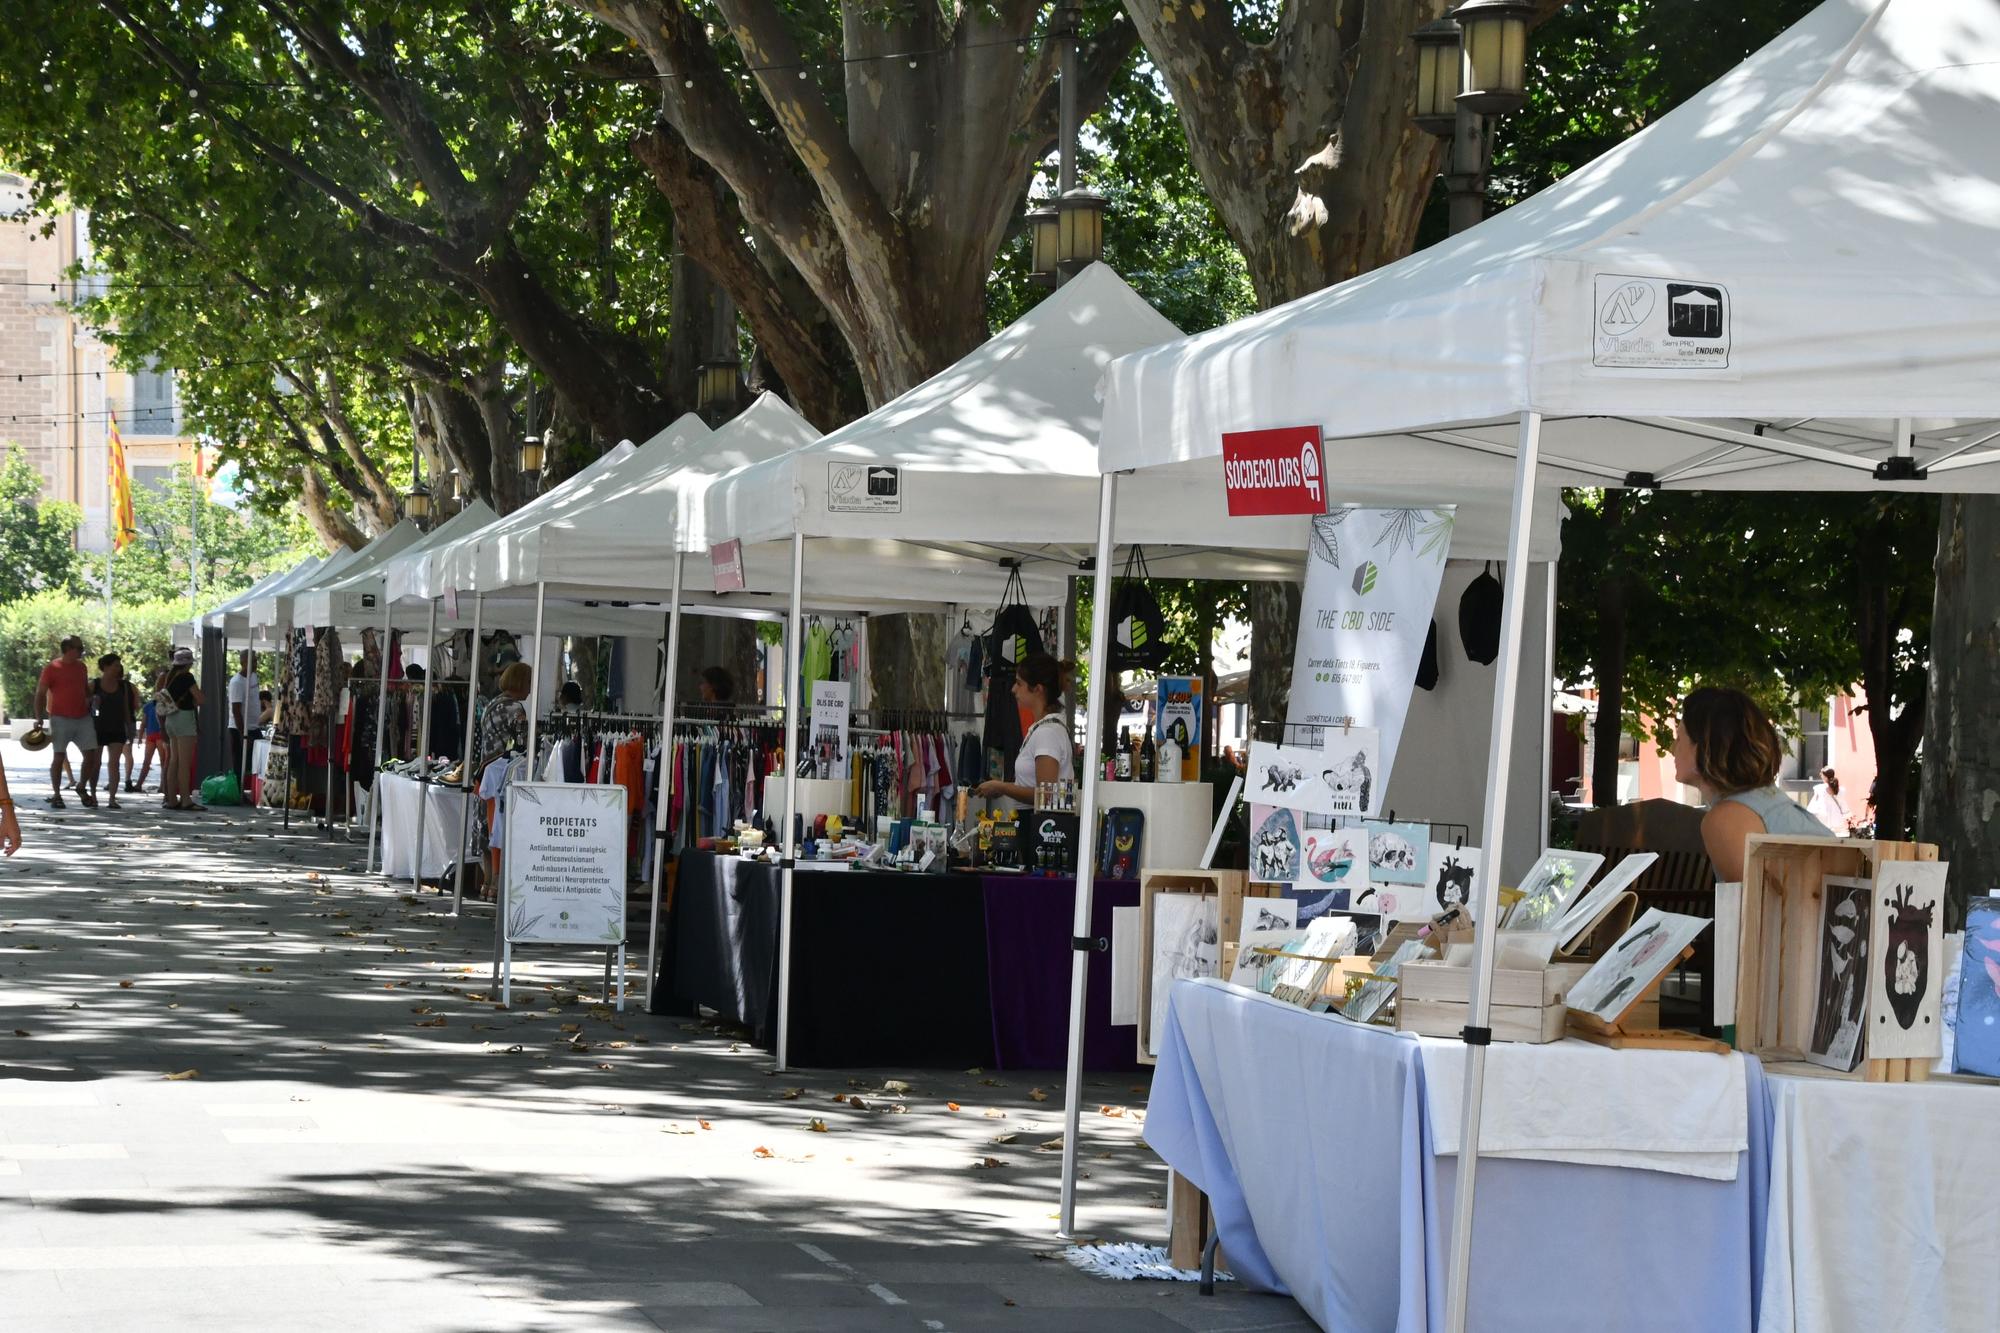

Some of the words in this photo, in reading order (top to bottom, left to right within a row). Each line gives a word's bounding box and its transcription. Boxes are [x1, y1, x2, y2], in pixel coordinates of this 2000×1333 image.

[1599, 336, 1654, 353] Viada
[1695, 347, 1724, 355] ENDURO
[1225, 453, 1301, 490] SÓCDECOLORS
[1316, 609, 1337, 630] THE
[1341, 611, 1364, 631] CBD
[1367, 612, 1395, 632] SIDE
[1307, 658, 1322, 668] Carrer
[1322, 658, 1334, 668] dels
[540, 816, 597, 827] PROPIETATS
[547, 828, 564, 837] DEL
[529, 844, 574, 853] Antiinflamatori
[541, 854, 595, 863] Anticonvulsionant
[525, 874, 561, 882] Antitumoral
[565, 875, 611, 884] Neuroprotector
